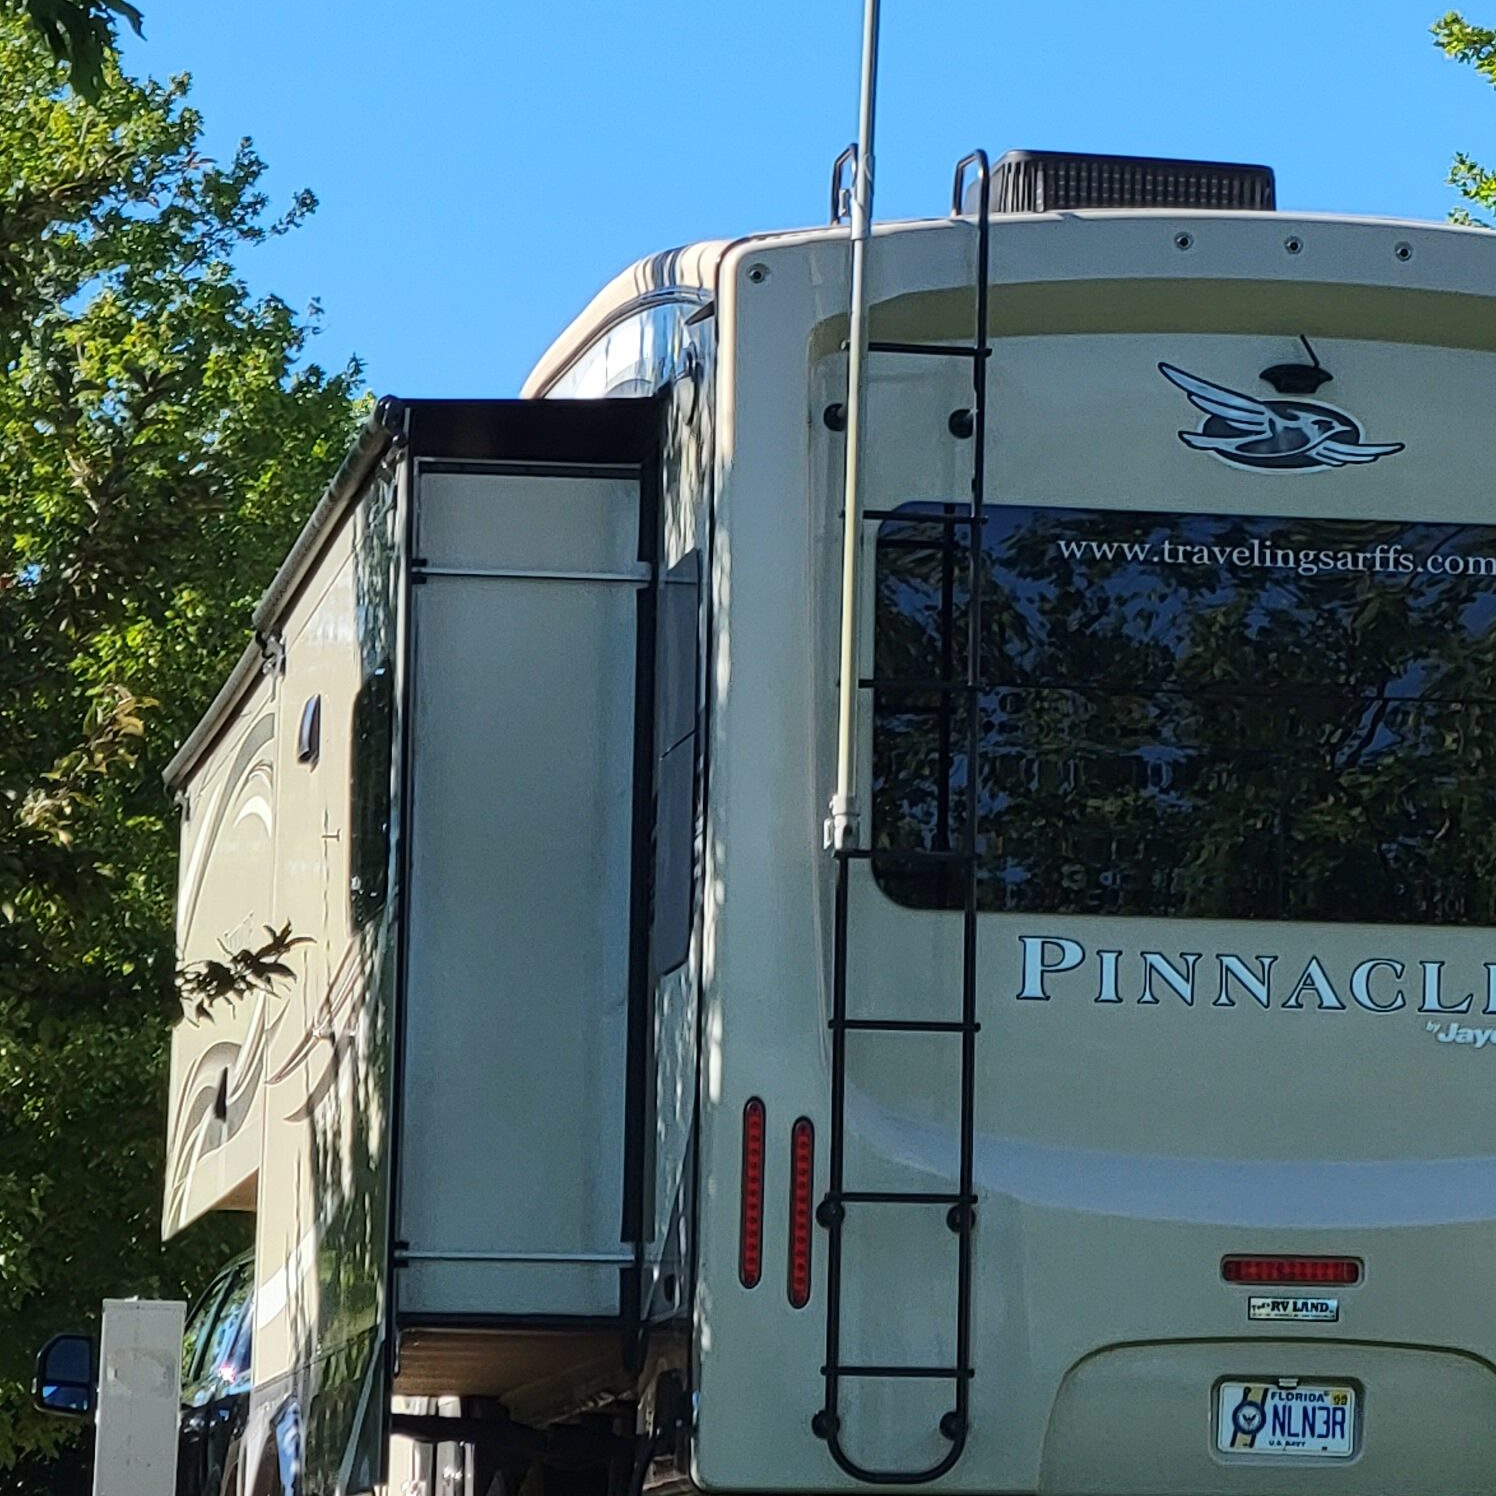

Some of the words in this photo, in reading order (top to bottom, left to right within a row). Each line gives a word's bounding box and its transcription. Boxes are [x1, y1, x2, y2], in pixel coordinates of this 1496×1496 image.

[1270, 1300, 1289, 1313] RV
[1292, 1301, 1329, 1313] LAND
[1270, 1391, 1325, 1403] FLORIDA
[1271, 1403, 1346, 1440] NLN3R
